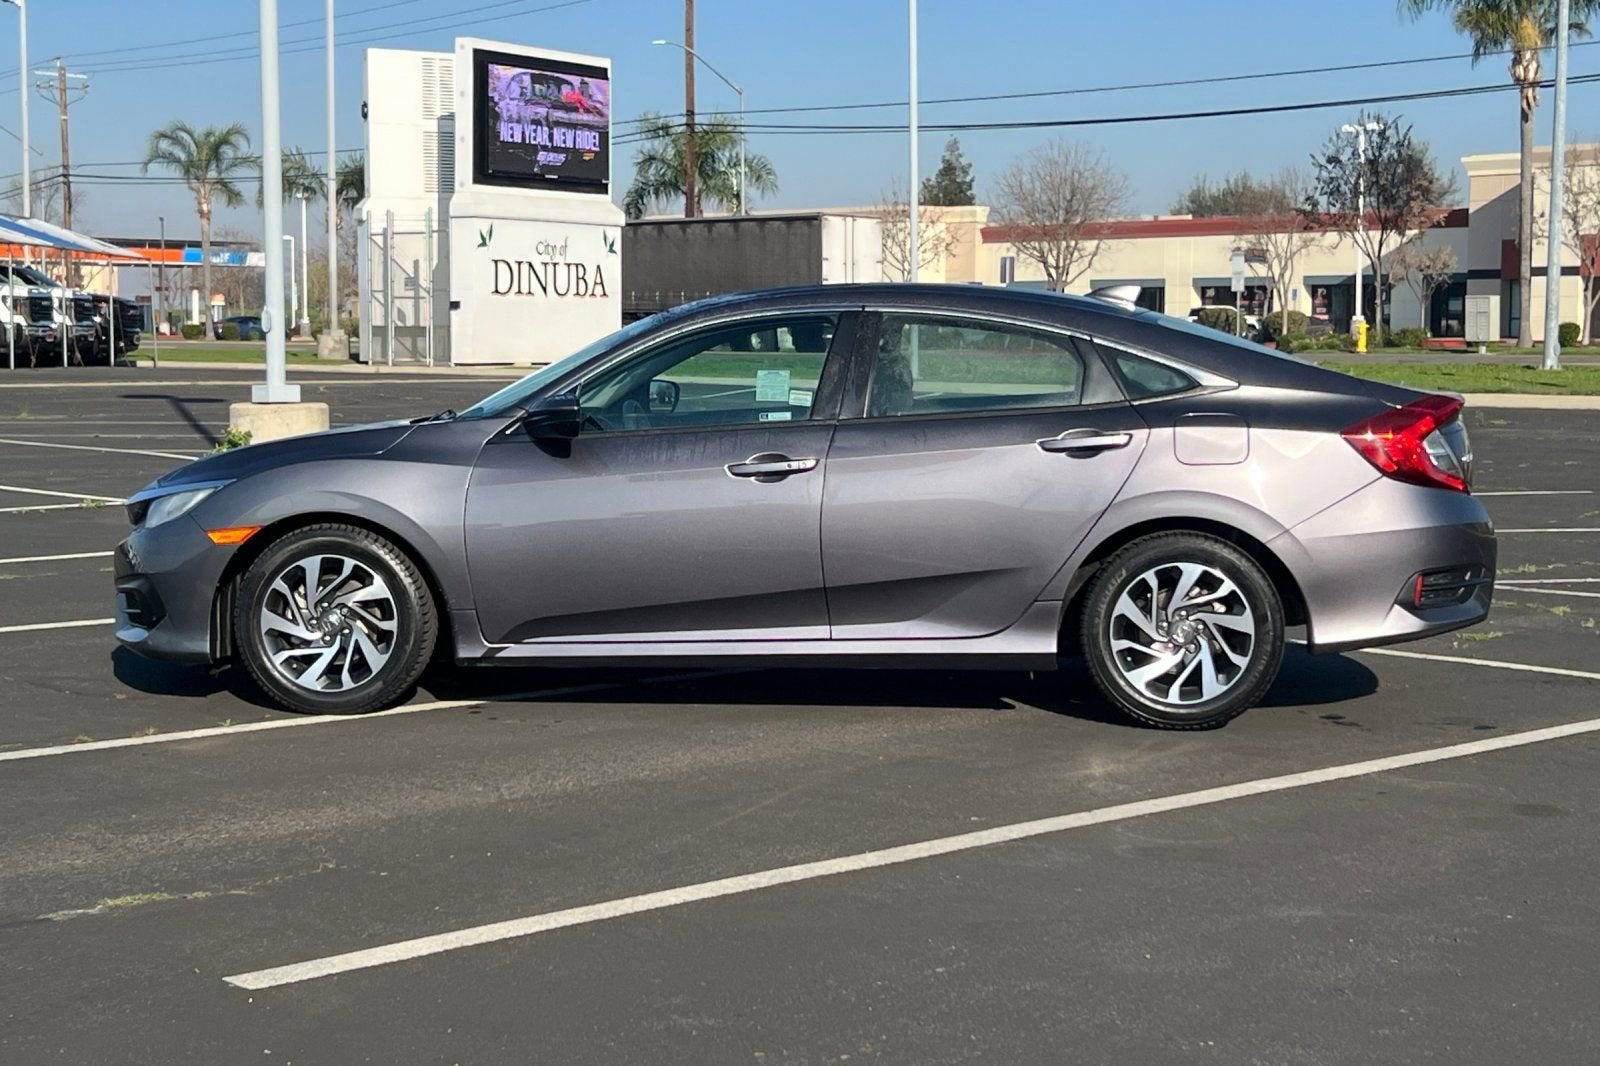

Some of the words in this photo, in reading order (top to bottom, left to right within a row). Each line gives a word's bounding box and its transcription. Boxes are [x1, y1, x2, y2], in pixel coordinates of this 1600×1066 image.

[500, 120, 522, 143] NEW
[524, 123, 552, 148] YEAR,
[553, 127, 575, 148] NEW
[575, 129, 600, 151] RIDE!
[535, 240, 558, 261] City
[559, 236, 569, 261] of
[491, 258, 609, 298] DINUBA
